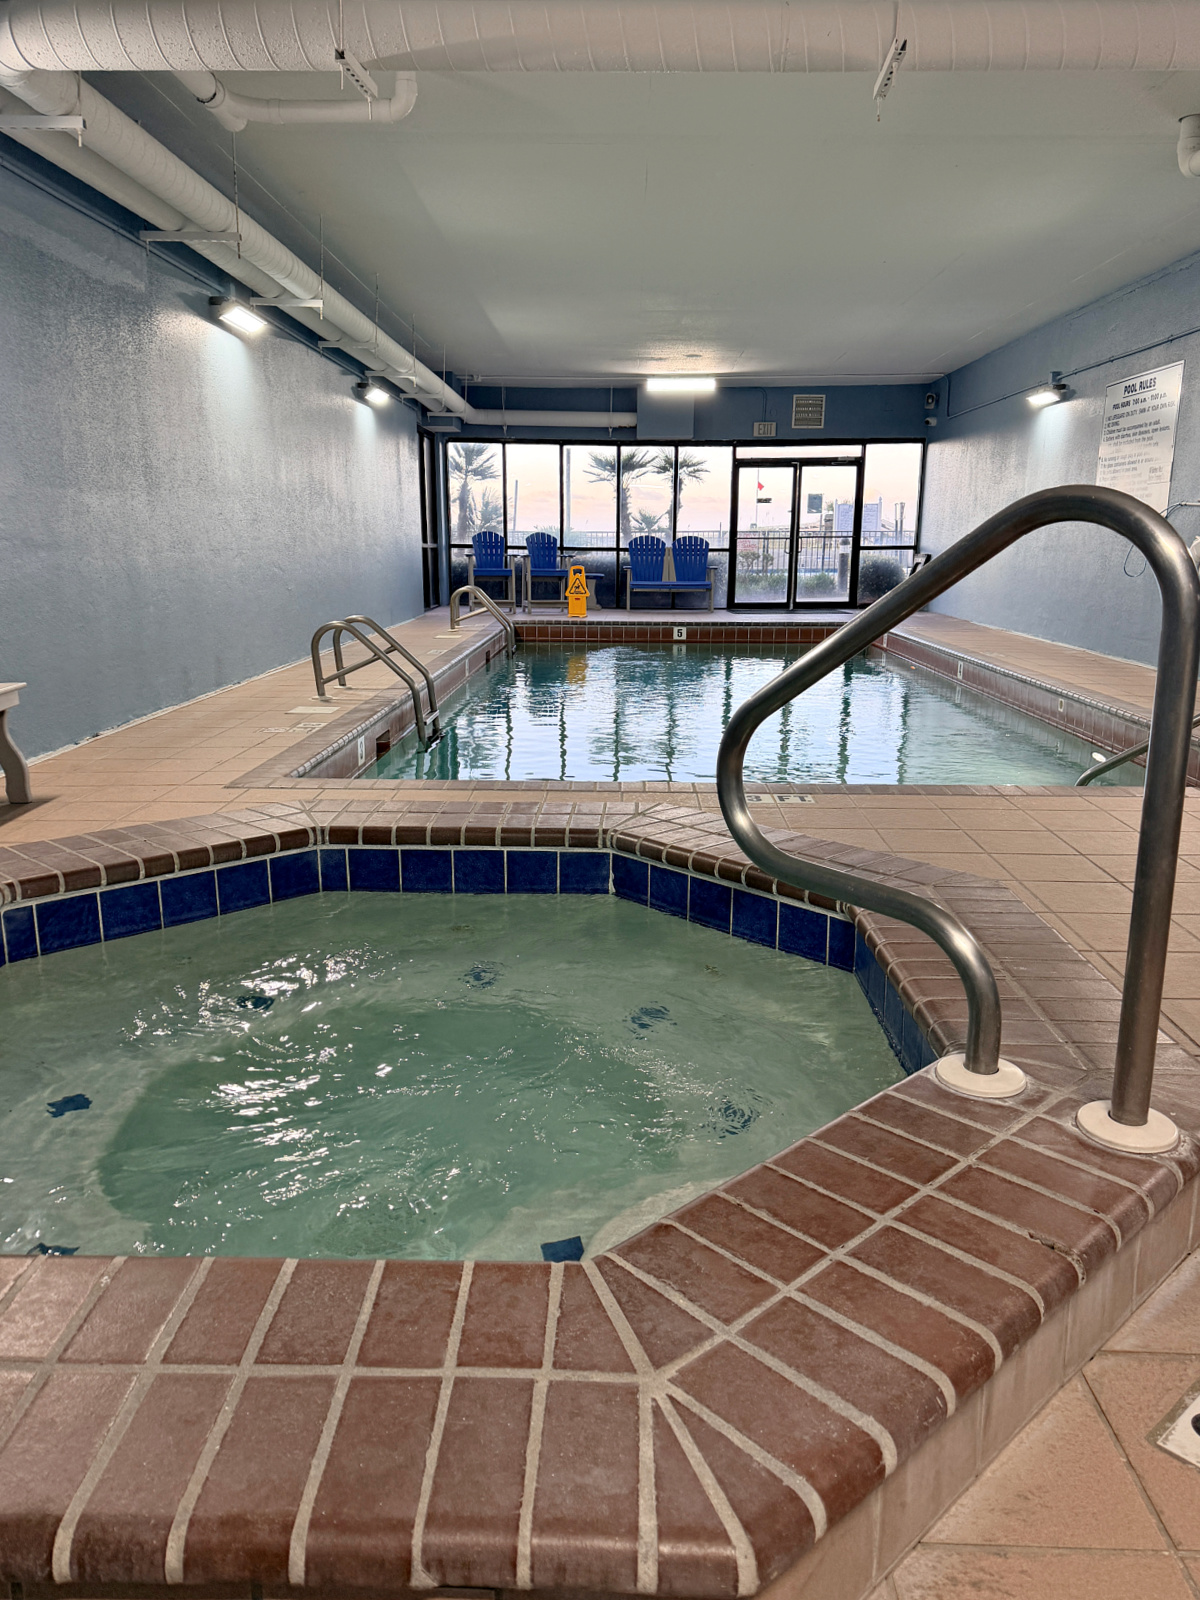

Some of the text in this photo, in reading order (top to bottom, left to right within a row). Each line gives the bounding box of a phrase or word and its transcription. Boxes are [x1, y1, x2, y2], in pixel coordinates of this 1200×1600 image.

[1123, 377, 1157, 395] POOL RULES
[1112, 402, 1120, 410] POOL
[758, 423, 774, 435] EXIT
[677, 628, 683, 638] 5
